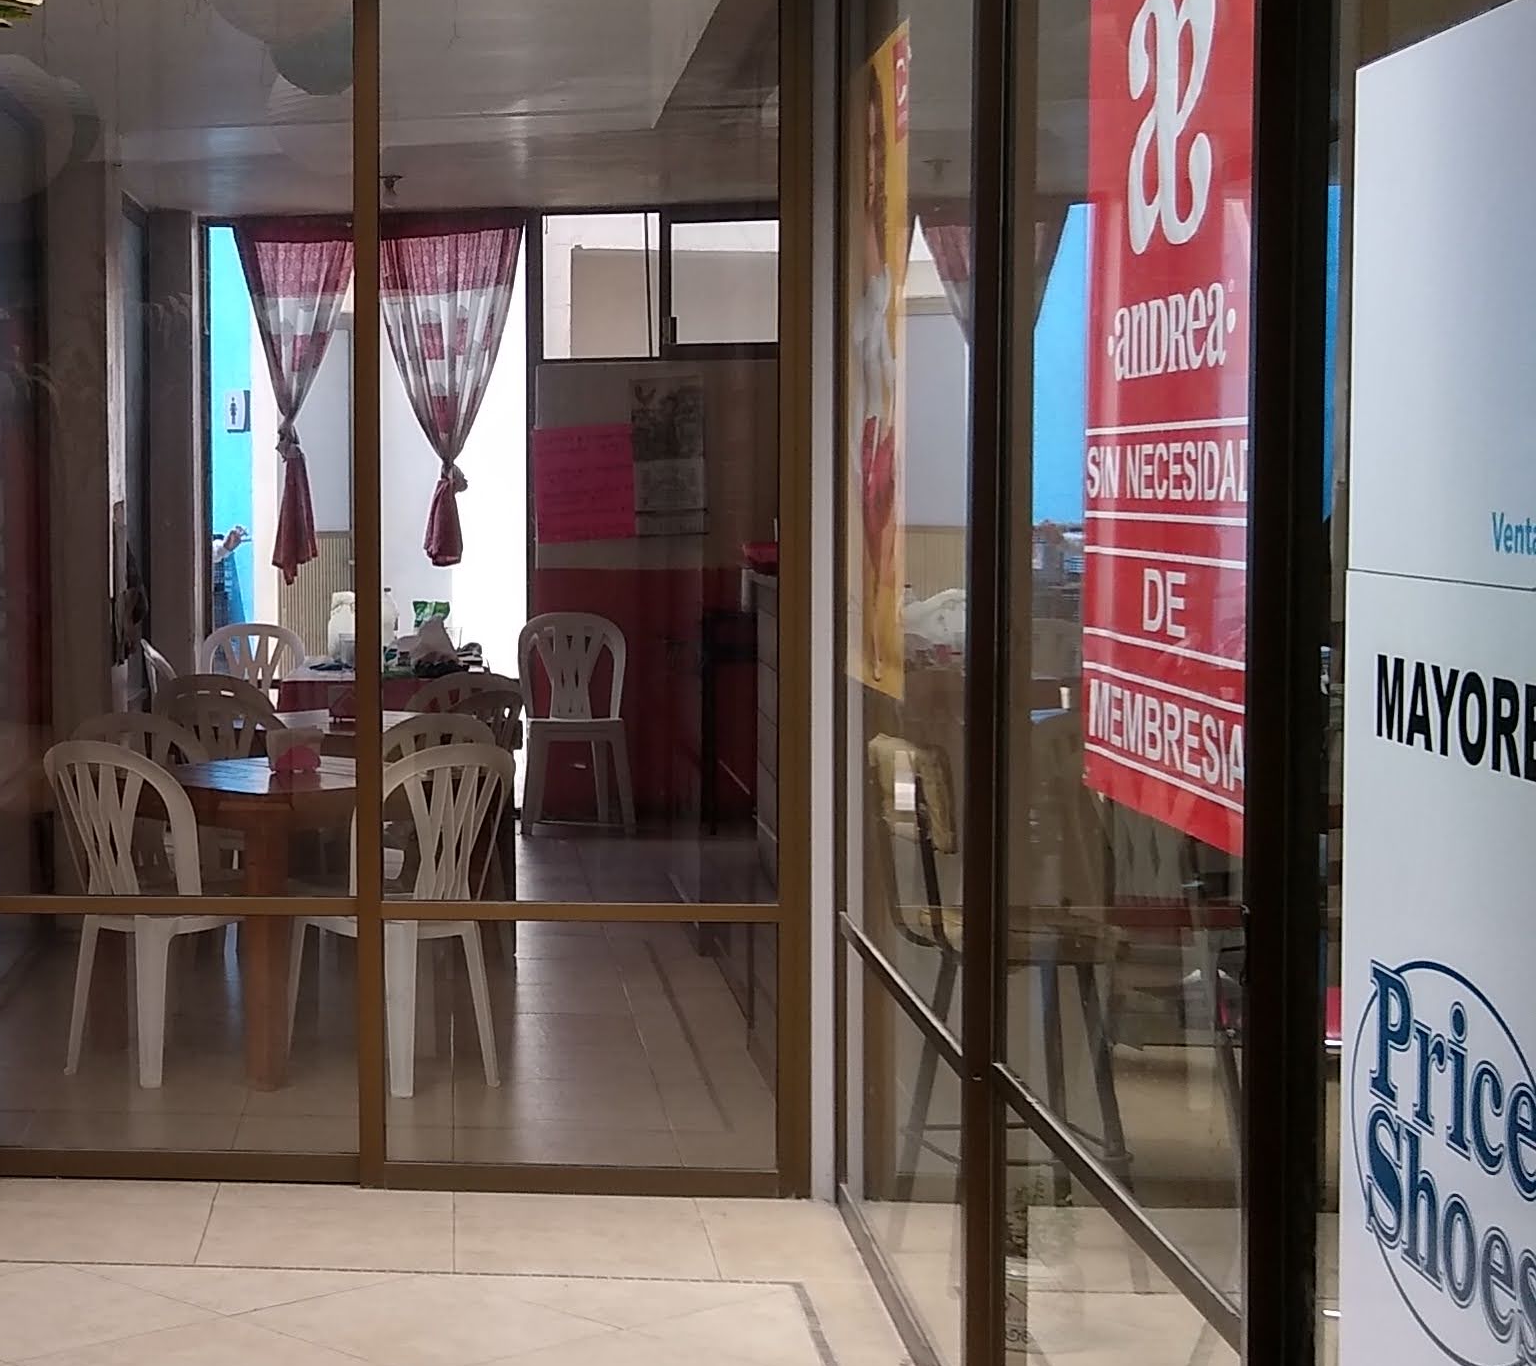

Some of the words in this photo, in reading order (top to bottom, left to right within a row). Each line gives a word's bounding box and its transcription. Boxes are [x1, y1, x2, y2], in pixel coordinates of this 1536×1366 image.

[1086, 445, 1121, 500] SIN
[1142, 567, 1187, 638] DE
[1088, 678, 1246, 792] MEMBRESIA
[1370, 958, 1536, 1202] Price
